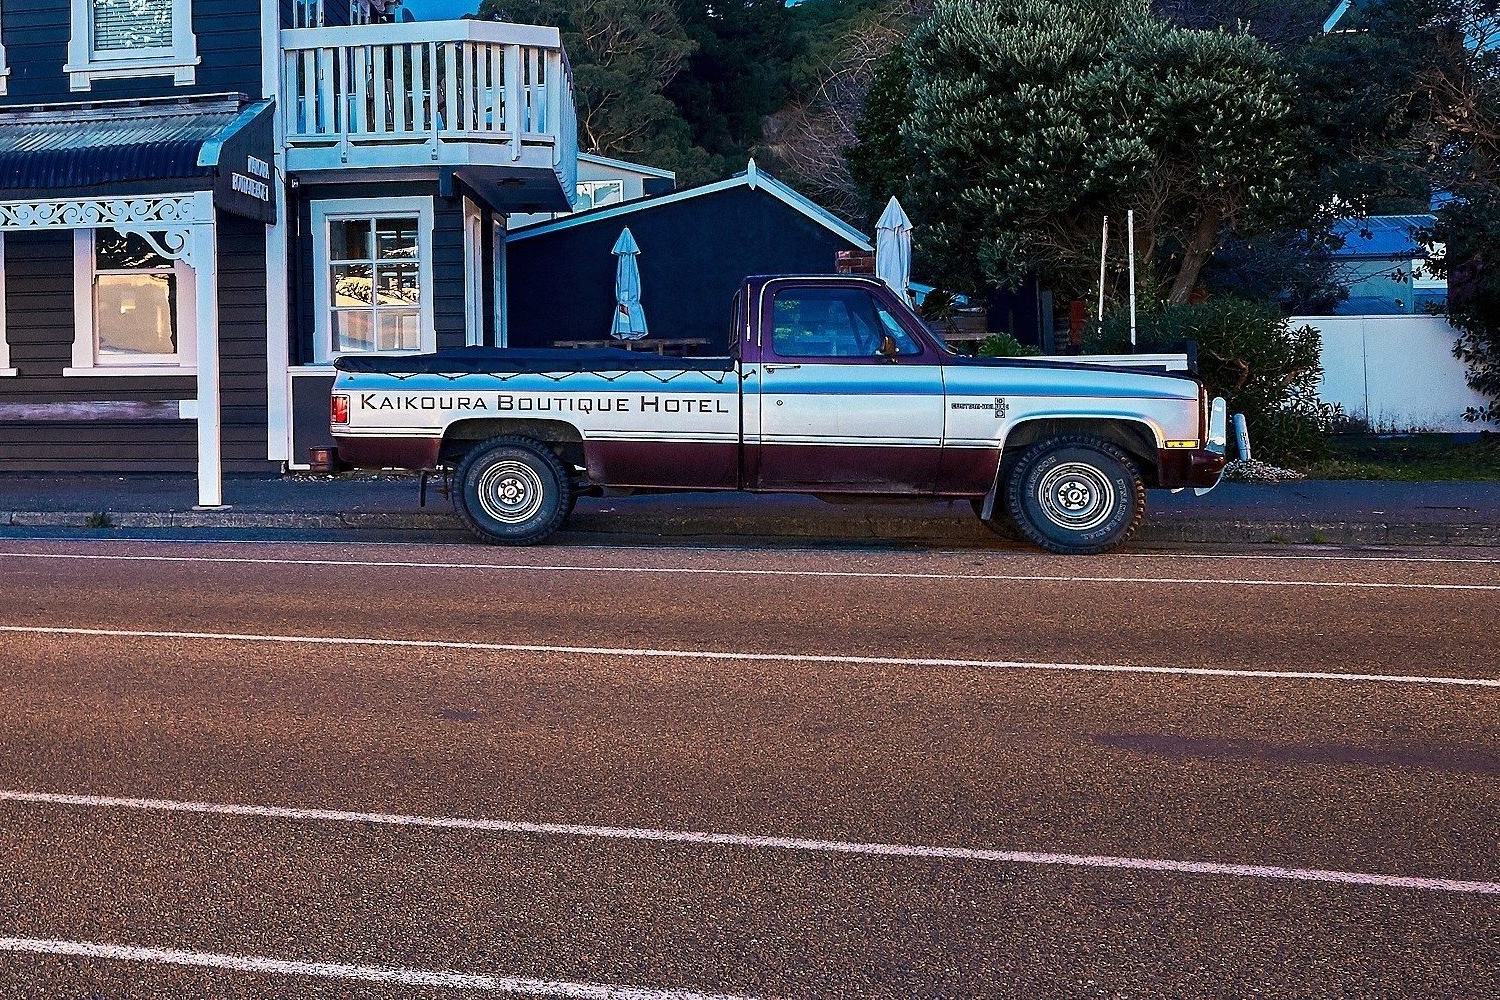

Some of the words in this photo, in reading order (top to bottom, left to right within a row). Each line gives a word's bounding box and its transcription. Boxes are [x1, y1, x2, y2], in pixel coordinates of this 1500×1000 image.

[361, 393, 488, 411] KAIKOURA
[497, 395, 630, 414] BOUTIQUE
[640, 396, 729, 413] HOTEL
